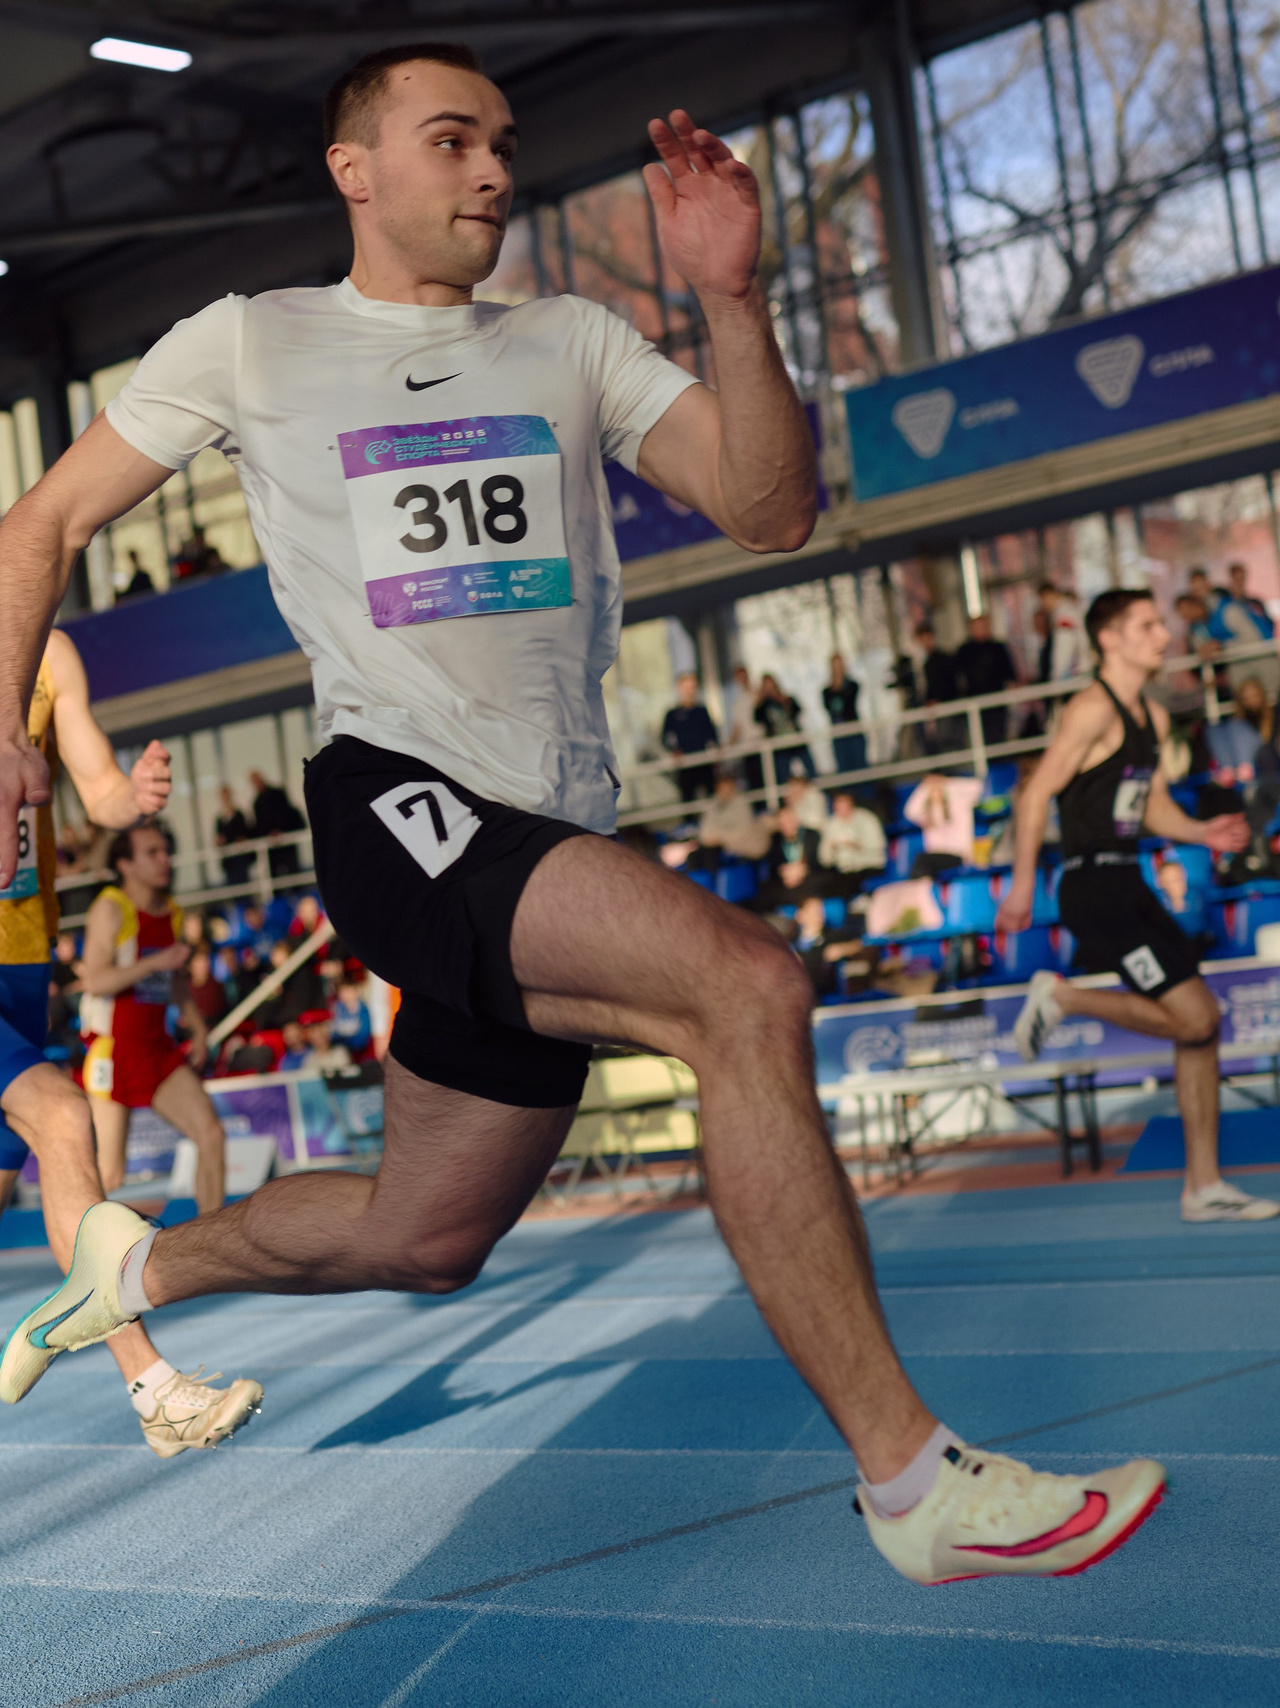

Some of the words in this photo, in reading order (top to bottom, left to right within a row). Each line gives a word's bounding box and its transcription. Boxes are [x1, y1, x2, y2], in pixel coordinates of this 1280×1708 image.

[441, 429, 486, 441] 2025
[393, 474, 527, 553] 318
[395, 789, 449, 847] 7
[1133, 957, 1156, 982] 2
